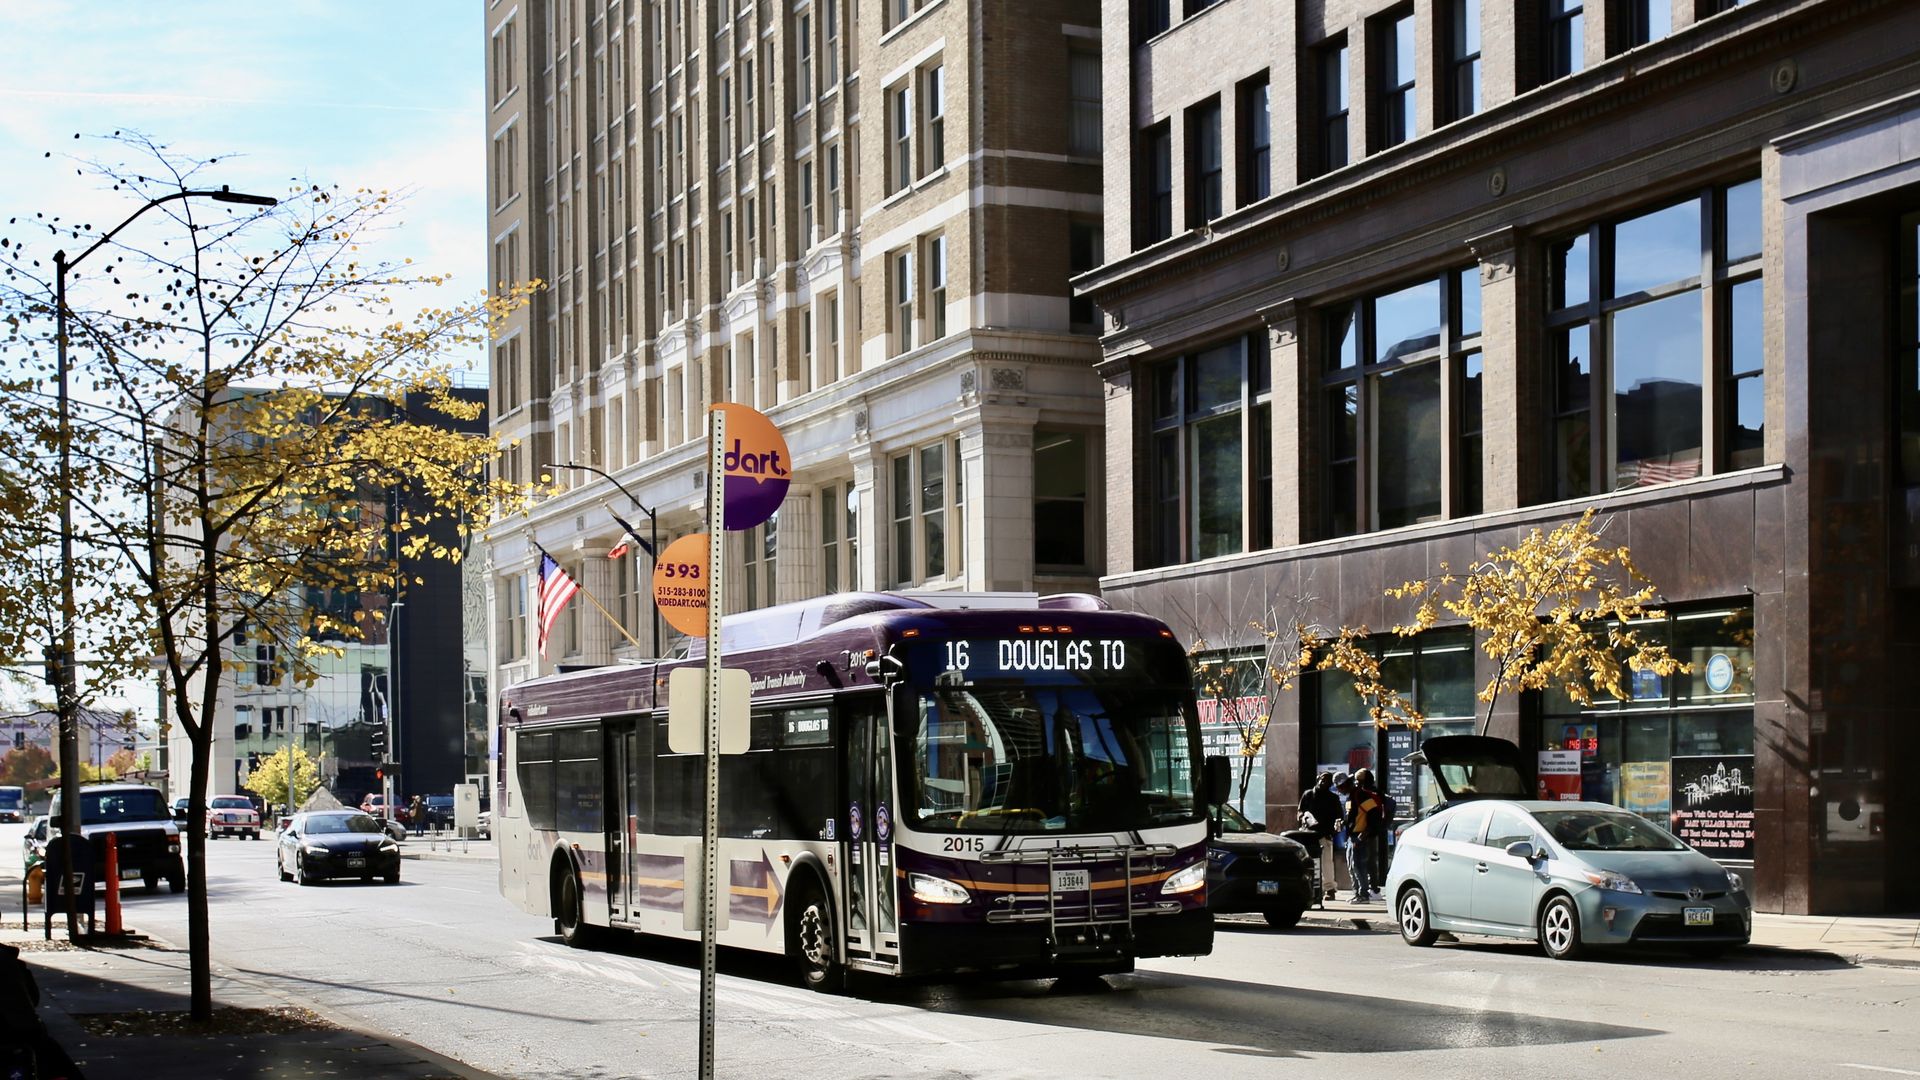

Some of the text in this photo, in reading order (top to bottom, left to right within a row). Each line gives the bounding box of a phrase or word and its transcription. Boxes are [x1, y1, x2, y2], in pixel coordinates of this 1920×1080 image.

[658, 587, 706, 598] 515-283-8100
[657, 598, 707, 608] RIDEDART.COM
[850, 651, 867, 667] 2015
[945, 640, 1125, 670] 16 DOUGLAS TO
[767, 674, 783, 689] Transit
[783, 670, 807, 689] Authority
[797, 720, 820, 732] DOUGLAS
[820, 719, 829, 731] TO
[1707, 810, 1718, 818] Our
[1719, 810, 1735, 818] Other
[1700, 820, 1725, 828] VILLAGE
[1726, 820, 1750, 828] PANTRY
[943, 837, 984, 852] 2015
[1701, 839, 1719, 847] Moines
